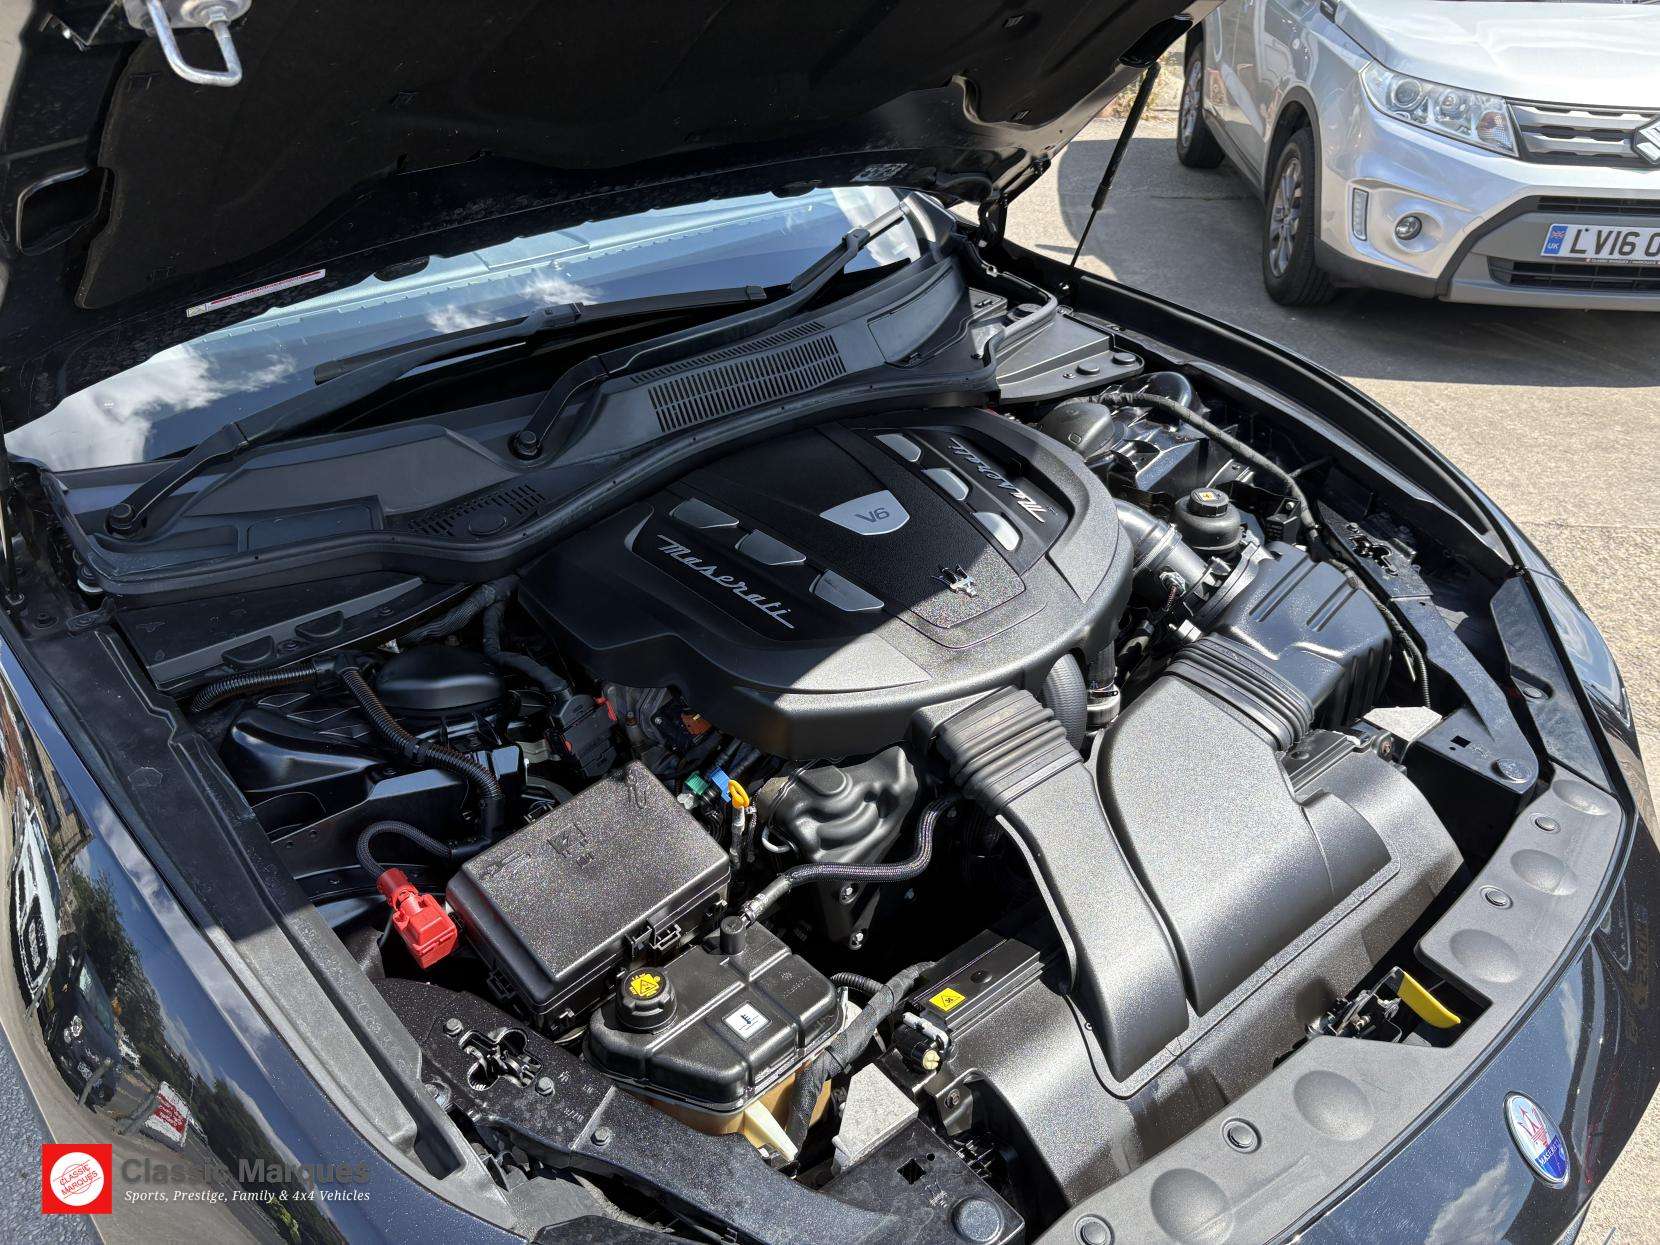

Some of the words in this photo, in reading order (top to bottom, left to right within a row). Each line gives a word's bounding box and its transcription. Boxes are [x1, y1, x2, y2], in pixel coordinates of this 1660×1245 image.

[1547, 242, 1558, 250] UK
[1569, 229, 1641, 256] LV16
[854, 507, 890, 523] V6
[657, 534, 796, 629] Maserati
